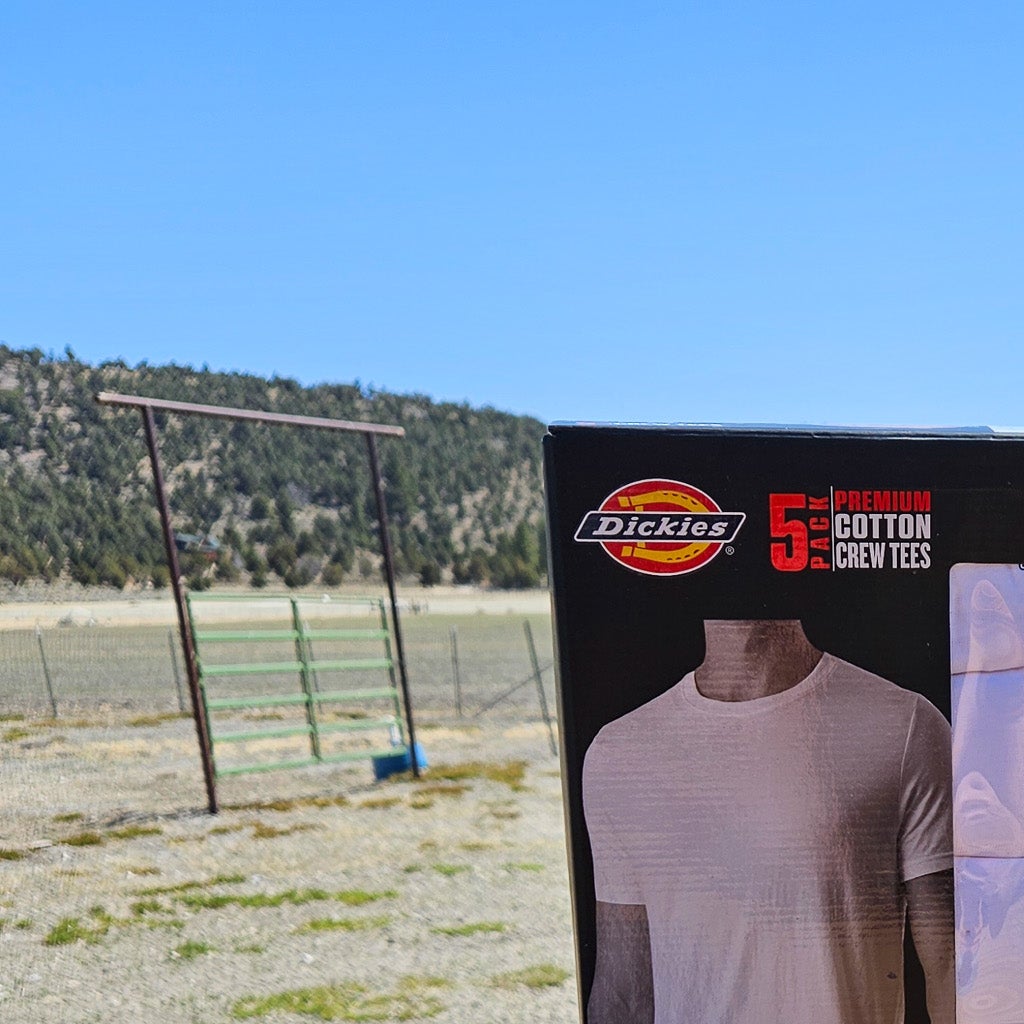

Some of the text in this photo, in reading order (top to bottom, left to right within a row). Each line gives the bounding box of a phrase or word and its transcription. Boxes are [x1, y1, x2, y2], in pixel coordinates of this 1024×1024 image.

[835, 491, 931, 511] PREMIUM
[592, 516, 729, 537] Dickies
[769, 493, 809, 572] 5
[808, 495, 831, 570] PACK
[835, 513, 931, 539] COTTON
[836, 542, 931, 569] CREW TEES
